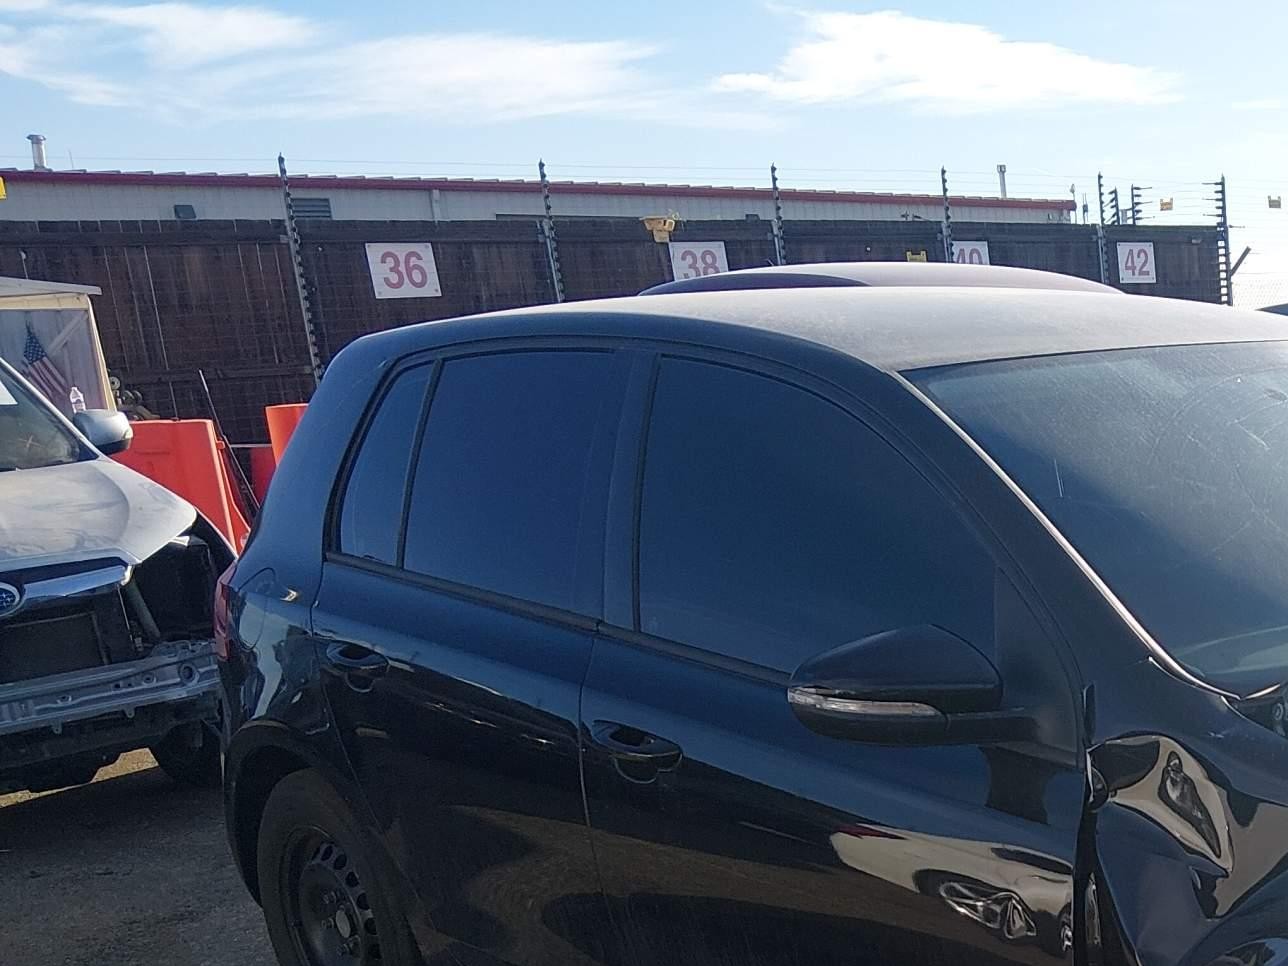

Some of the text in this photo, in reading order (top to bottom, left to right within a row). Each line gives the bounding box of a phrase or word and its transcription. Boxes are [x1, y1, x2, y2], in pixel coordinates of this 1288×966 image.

[380, 250, 428, 289] 36
[681, 249, 721, 279] 38
[1124, 248, 1150, 276] 42
